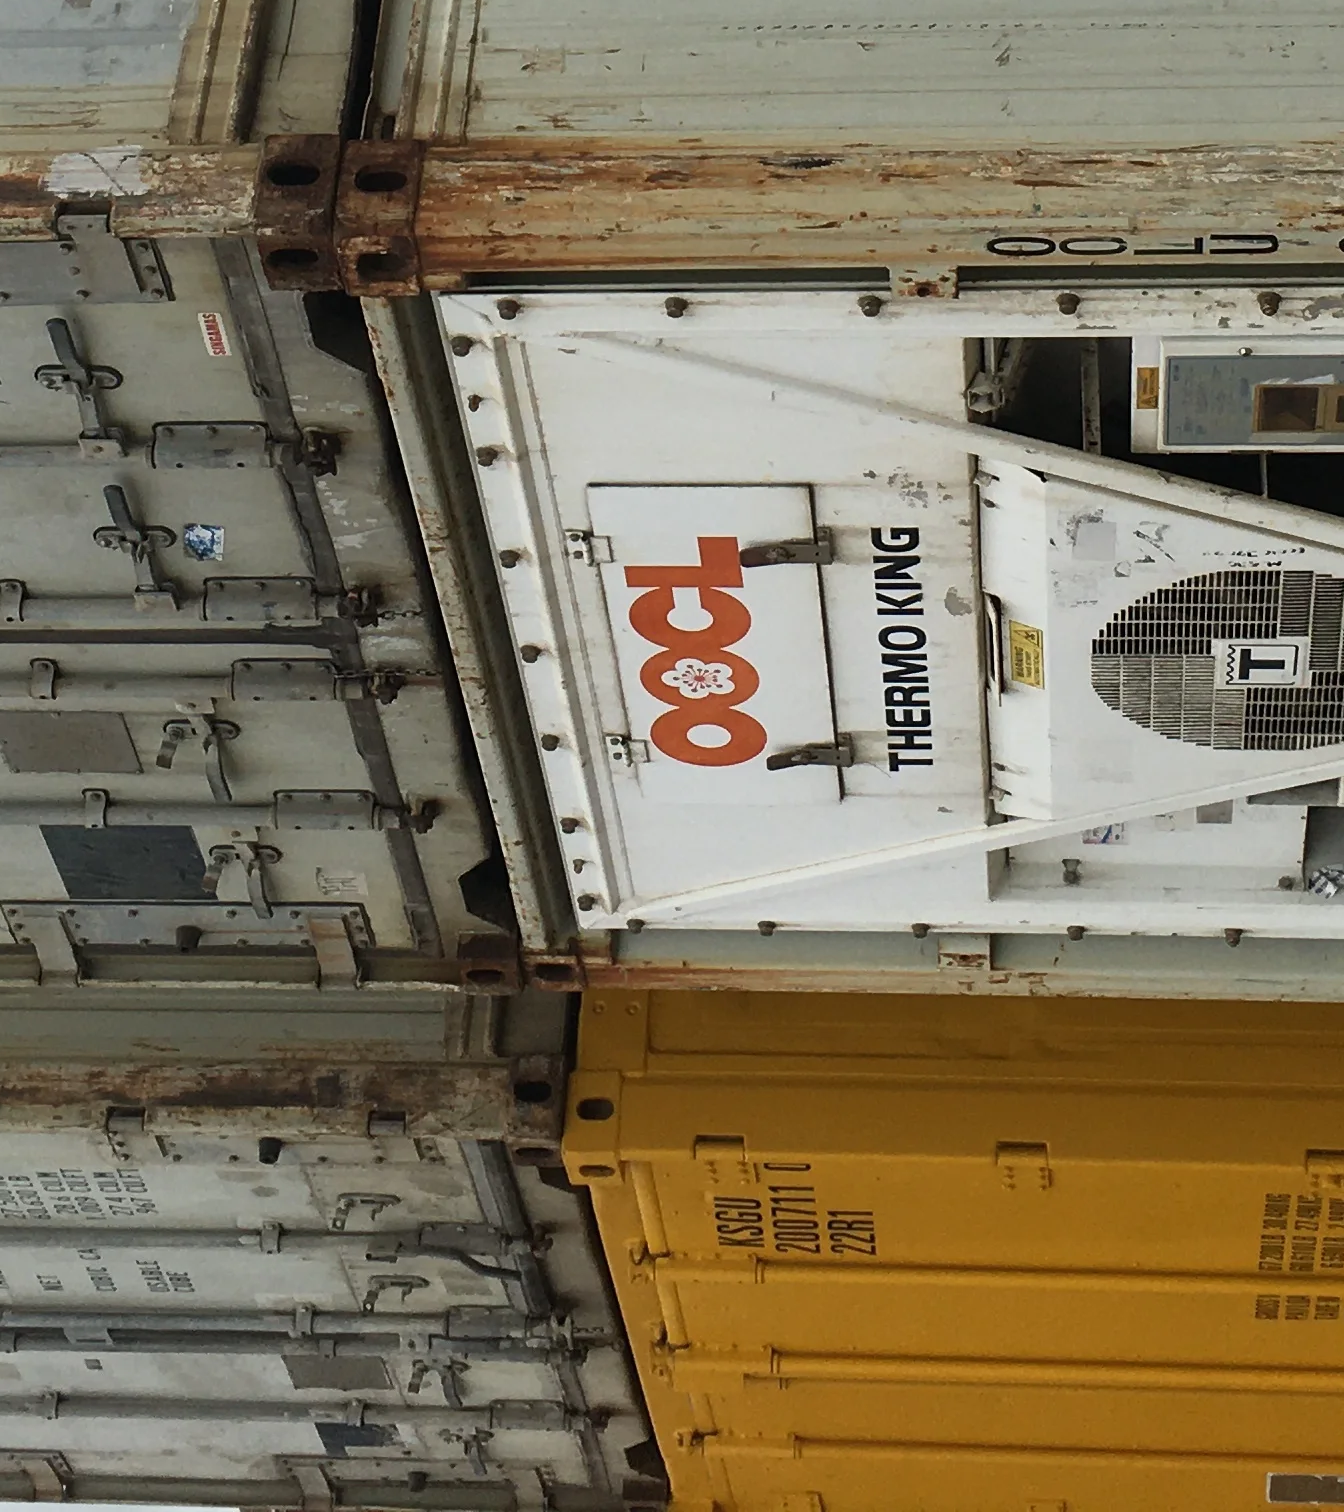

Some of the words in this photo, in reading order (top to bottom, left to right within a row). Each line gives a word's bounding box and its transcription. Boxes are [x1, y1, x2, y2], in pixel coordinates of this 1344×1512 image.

[870, 527, 924, 616] KING
[623, 536, 767, 766] OOCL
[1239, 648, 1285, 680] T
[877, 626, 934, 772] THERMO
[8, 1175, 33, 1188] LB
[713, 1196, 765, 1248] KSGU
[768, 1185, 821, 1254] 200711
[826, 1210, 877, 1256] 22R1
[77, 1248, 101, 1260] CA
[36, 1274, 64, 1291] NET
[86, 1266, 117, 1292] CUBIC
[136, 1260, 170, 1292] USABLE
[166, 1271, 195, 1293] CUBE
